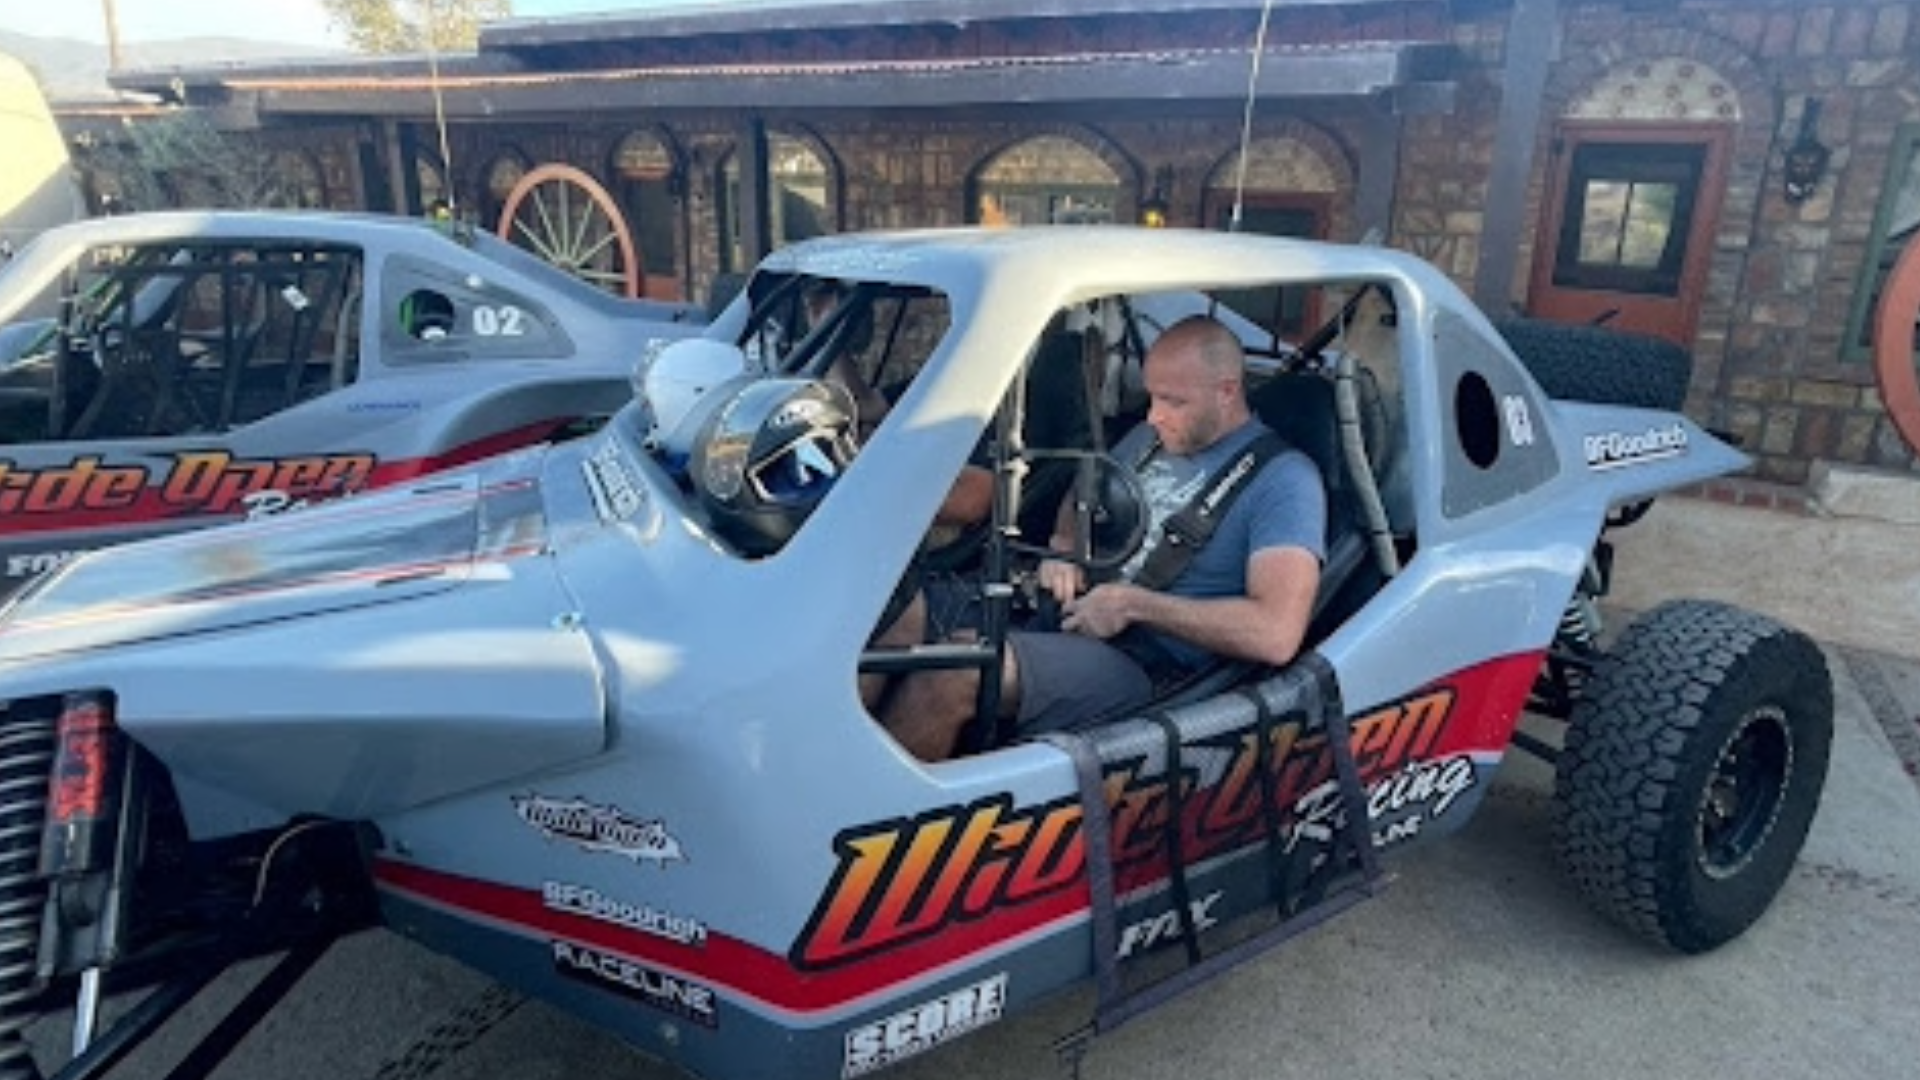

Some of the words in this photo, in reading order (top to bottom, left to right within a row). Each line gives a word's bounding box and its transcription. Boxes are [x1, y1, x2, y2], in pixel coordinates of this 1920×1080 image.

[473, 305, 524, 336] 02
[0, 456, 150, 513] ide
[160, 449, 375, 516] Open
[1282, 757, 1474, 854] Rcing
[553, 942, 714, 1014] RACELINE
[851, 976, 1003, 1054] SCORE
